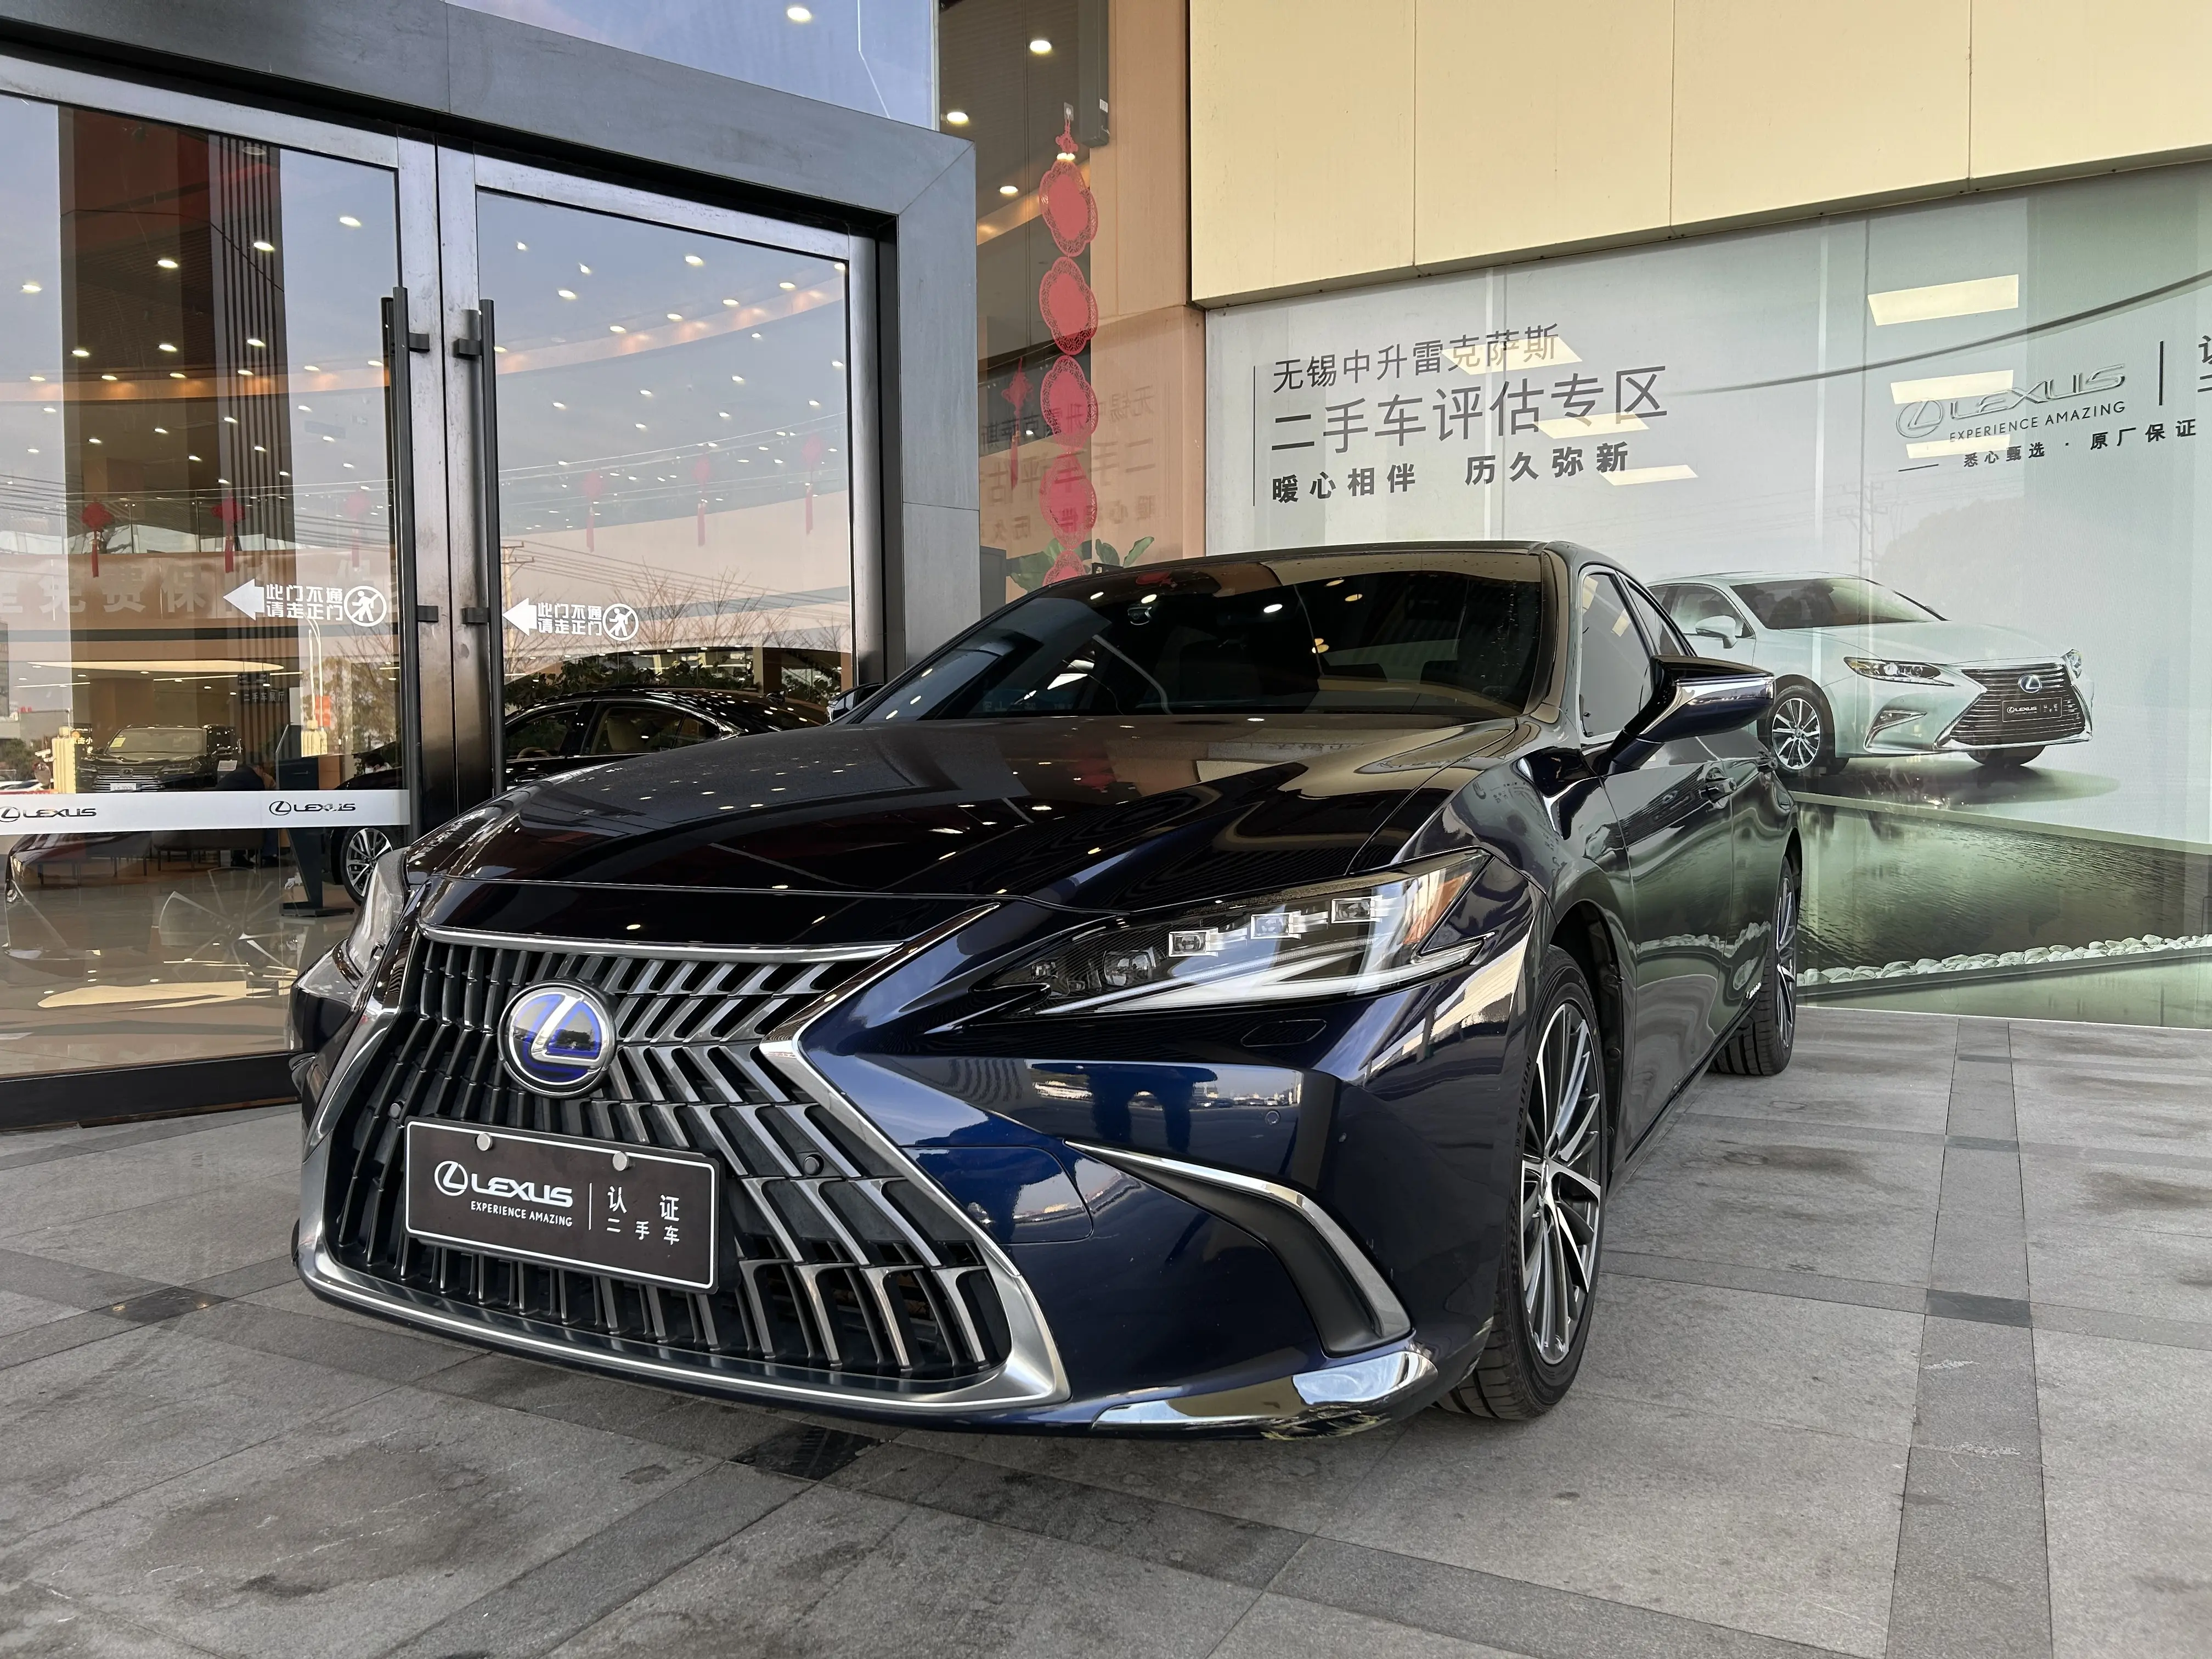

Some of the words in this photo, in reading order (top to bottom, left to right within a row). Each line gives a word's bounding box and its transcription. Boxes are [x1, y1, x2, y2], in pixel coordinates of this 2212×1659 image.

[1273, 323, 1559, 393] 无锡中升雷克萨斯
[1950, 363, 2125, 420] LEXUS
[1271, 365, 1668, 454] 二手车评估专区
[1950, 416, 2039, 443] EXPERIENCE
[2045, 401, 2126, 426] AMAZING
[1272, 464, 1416, 504] 暖心相伴
[1465, 442, 1629, 485] 历久弥新
[266, 584, 343, 603] 此门不通
[266, 601, 343, 621] 请走正门
[537, 602, 602, 620] 此门不通
[537, 618, 602, 636] 请走正门
[23, 808, 97, 818] LEXUS
[294, 803, 356, 812] LEXUS
[471, 1173, 573, 1207] LEXUS
[471, 1200, 526, 1219] EXPERIENCE
[529, 1211, 573, 1227] AMAZING
[606, 1218, 680, 1246] 二手车
